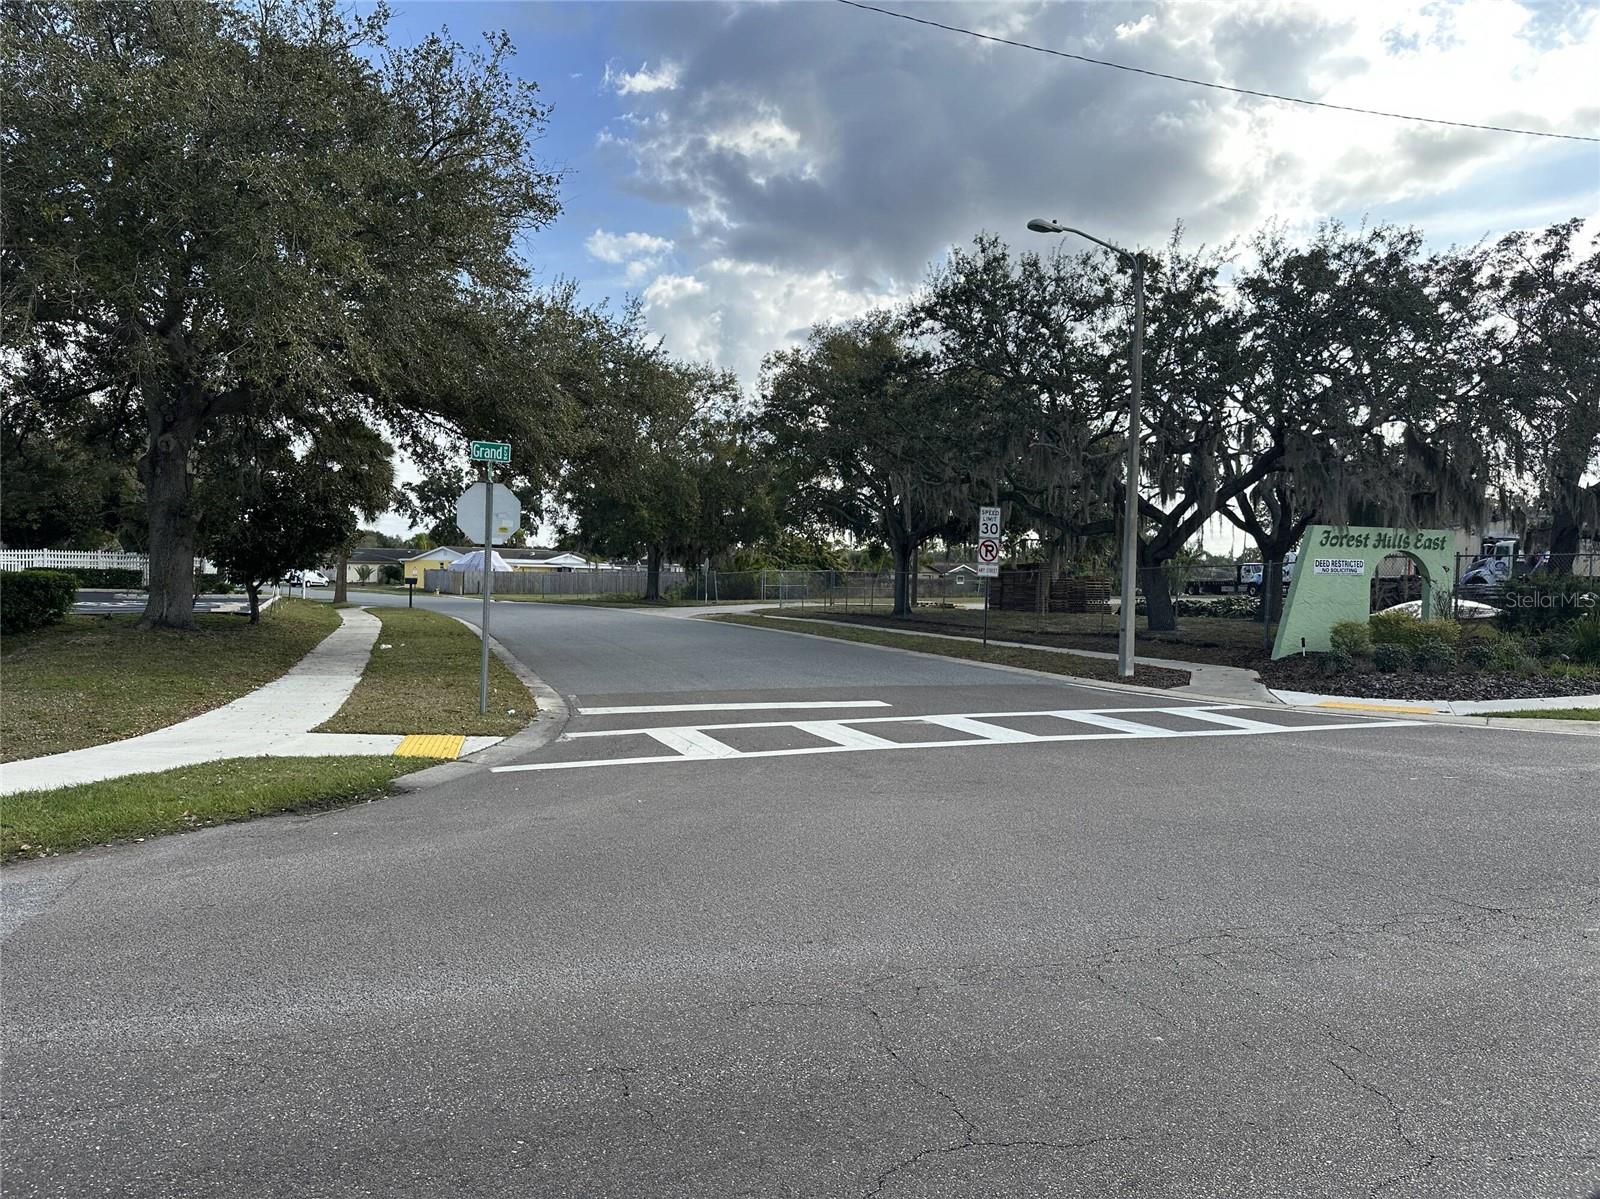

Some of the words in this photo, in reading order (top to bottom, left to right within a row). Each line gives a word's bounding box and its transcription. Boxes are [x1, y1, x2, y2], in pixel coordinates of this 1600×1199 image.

[473, 444, 502, 459] Grand
[981, 522, 998, 534] 30
[1320, 530, 1370, 548] Forest
[1372, 532, 1410, 549] Hills
[1414, 533, 1447, 550] East
[1315, 559, 1330, 568] DEED
[1331, 559, 1364, 568] RESTRICTED
